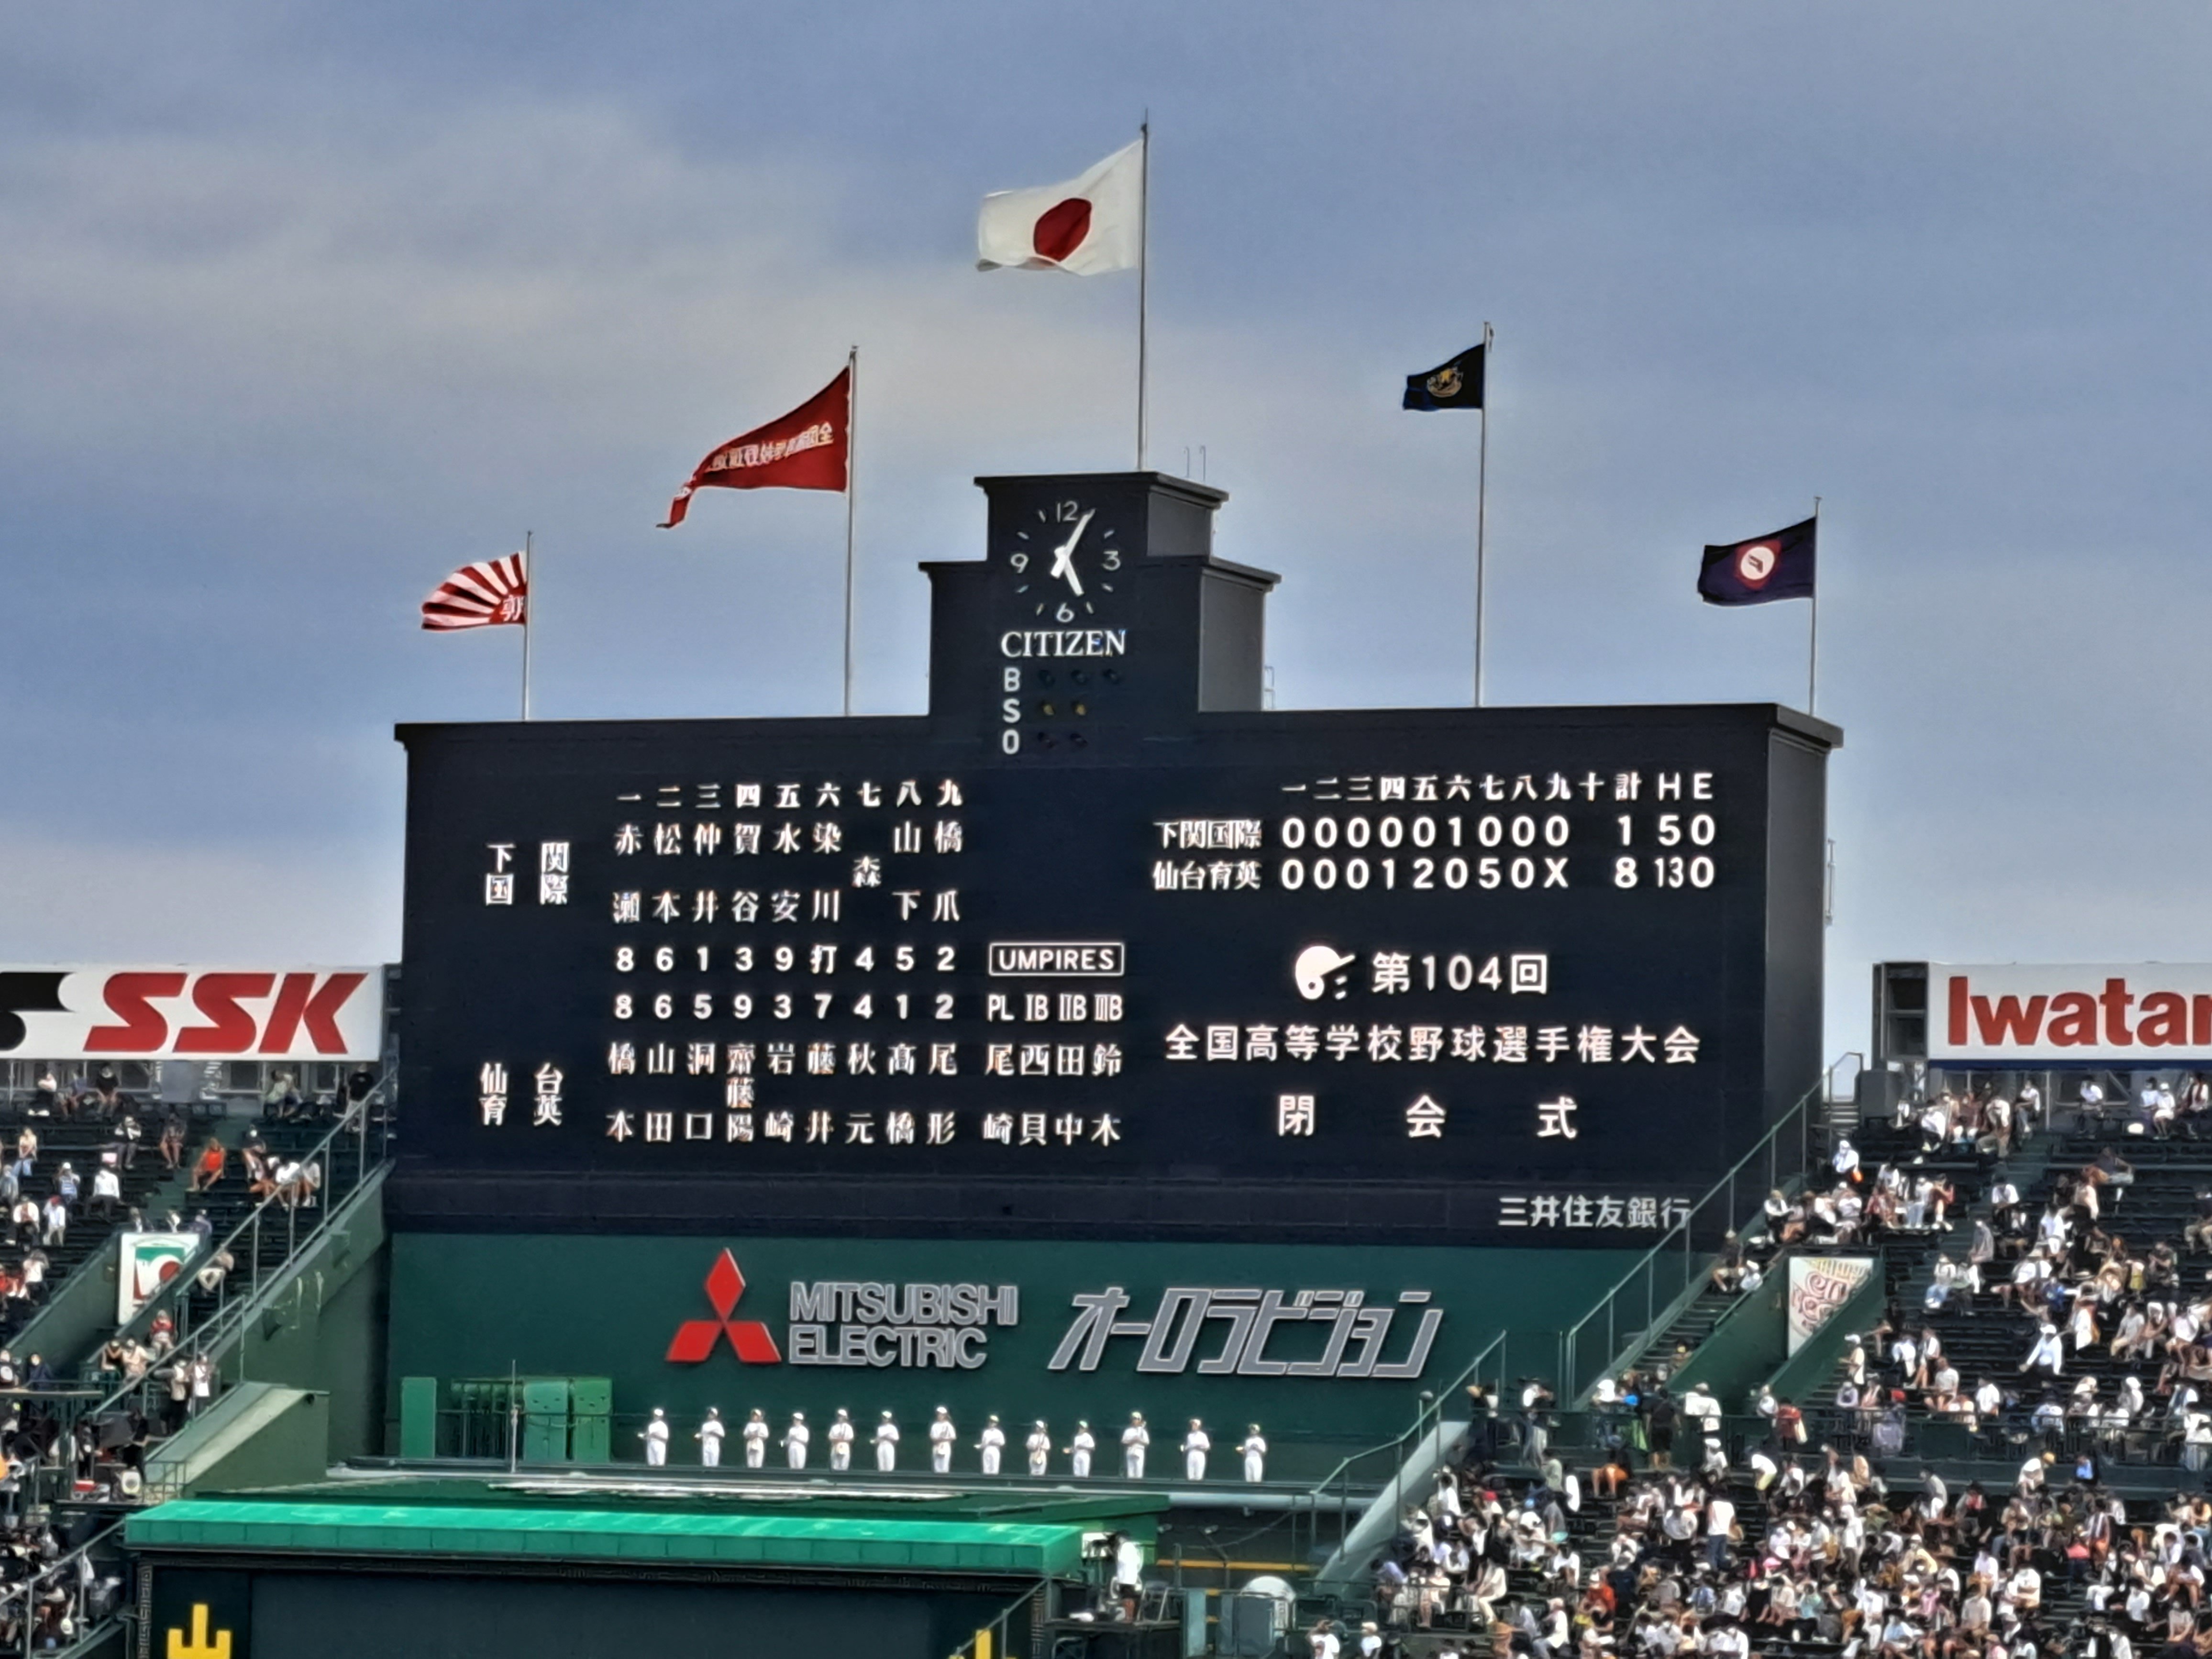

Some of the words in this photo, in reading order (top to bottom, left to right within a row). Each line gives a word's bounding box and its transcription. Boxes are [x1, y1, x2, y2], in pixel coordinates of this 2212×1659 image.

[1056, 501, 1078, 522] 12
[1010, 553, 1029, 573] 9
[1103, 551, 1121, 571] 3
[1056, 603, 1074, 623] 6
[1000, 630, 1126, 658] CITIZEN
[1004, 667, 1021, 692] B
[1003, 698, 1021, 723] S
[1002, 729, 1019, 754] O
[1154, 818, 1261, 850] 下関国際
[1152, 860, 1261, 890] 仙台育英
[998, 948, 1115, 971] UMPIRES
[1371, 951, 1548, 995] 第104回
[82, 972, 368, 1054] SSK
[987, 993, 1015, 1022] PL
[1165, 1023, 1700, 1063] 全国高等学校野球選手権大会
[1498, 1194, 1691, 1228] 三井住友銀行
[790, 1281, 1018, 1328] MITSUBISHI
[1047, 1286, 1444, 1378] オーロラビジョン
[789, 1325, 987, 1369] ELECTRIC
